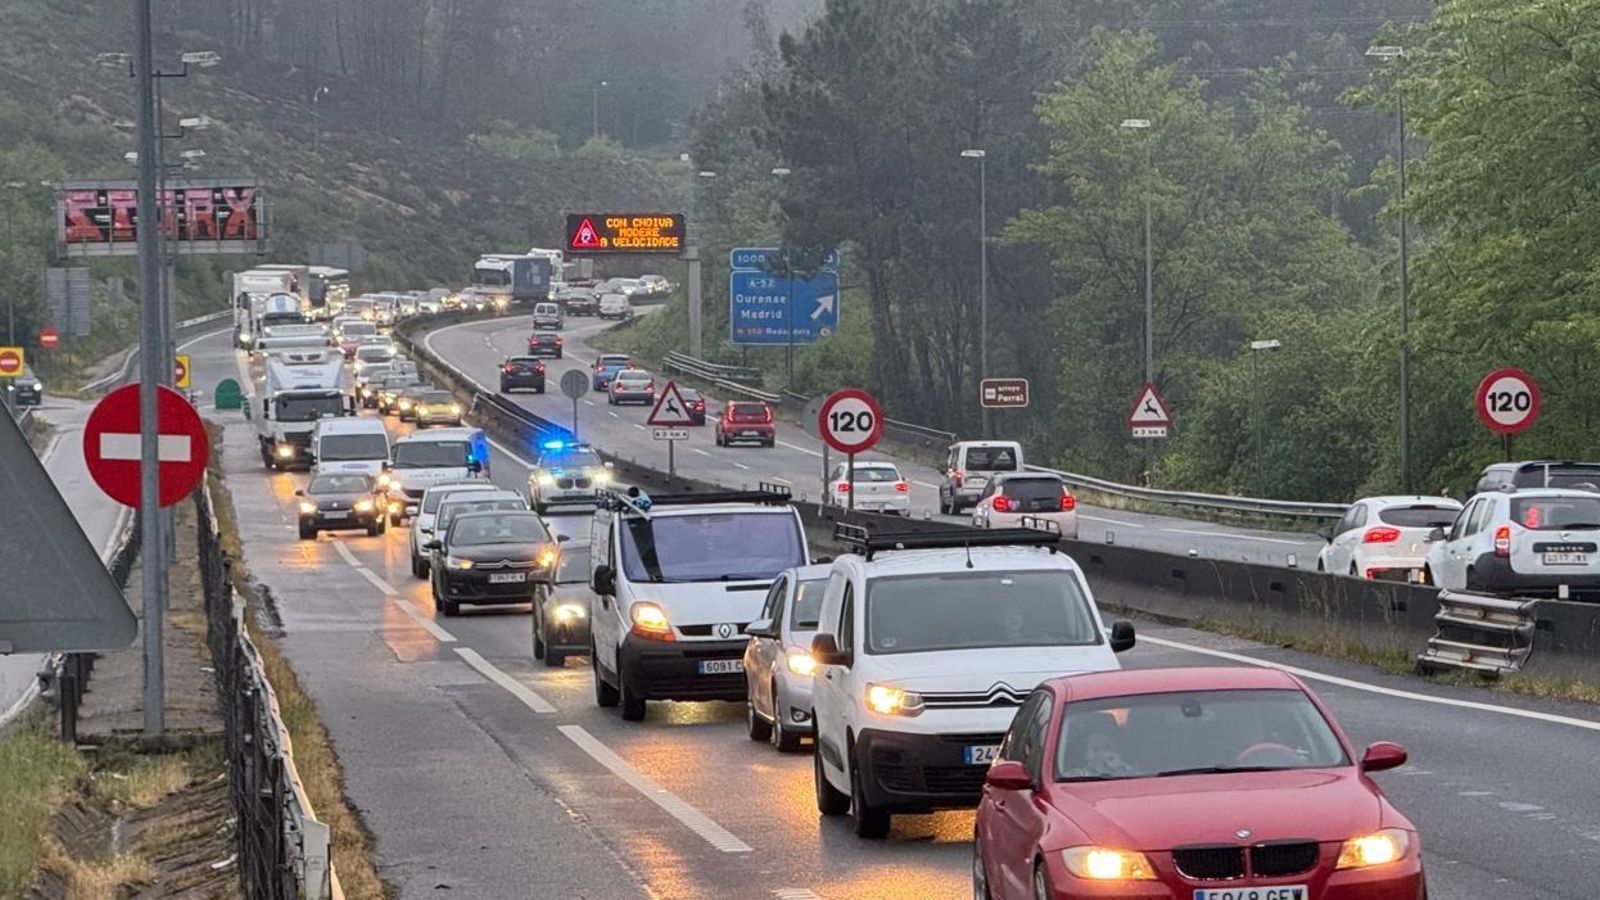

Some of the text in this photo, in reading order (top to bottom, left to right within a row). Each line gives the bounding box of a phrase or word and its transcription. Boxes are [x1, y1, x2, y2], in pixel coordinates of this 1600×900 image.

[606, 218, 673, 228] CON CHOIVA
[619, 228, 660, 237] MODERE
[600, 237, 678, 247] A VELOCIDADE
[737, 254, 766, 263] 1000
[748, 279, 776, 288] A-52
[736, 294, 787, 304] Ourense
[741, 309, 782, 319] Madrid
[1488, 391, 1530, 412] 120
[830, 411, 873, 432] 120
[706, 661, 731, 671] 6091
